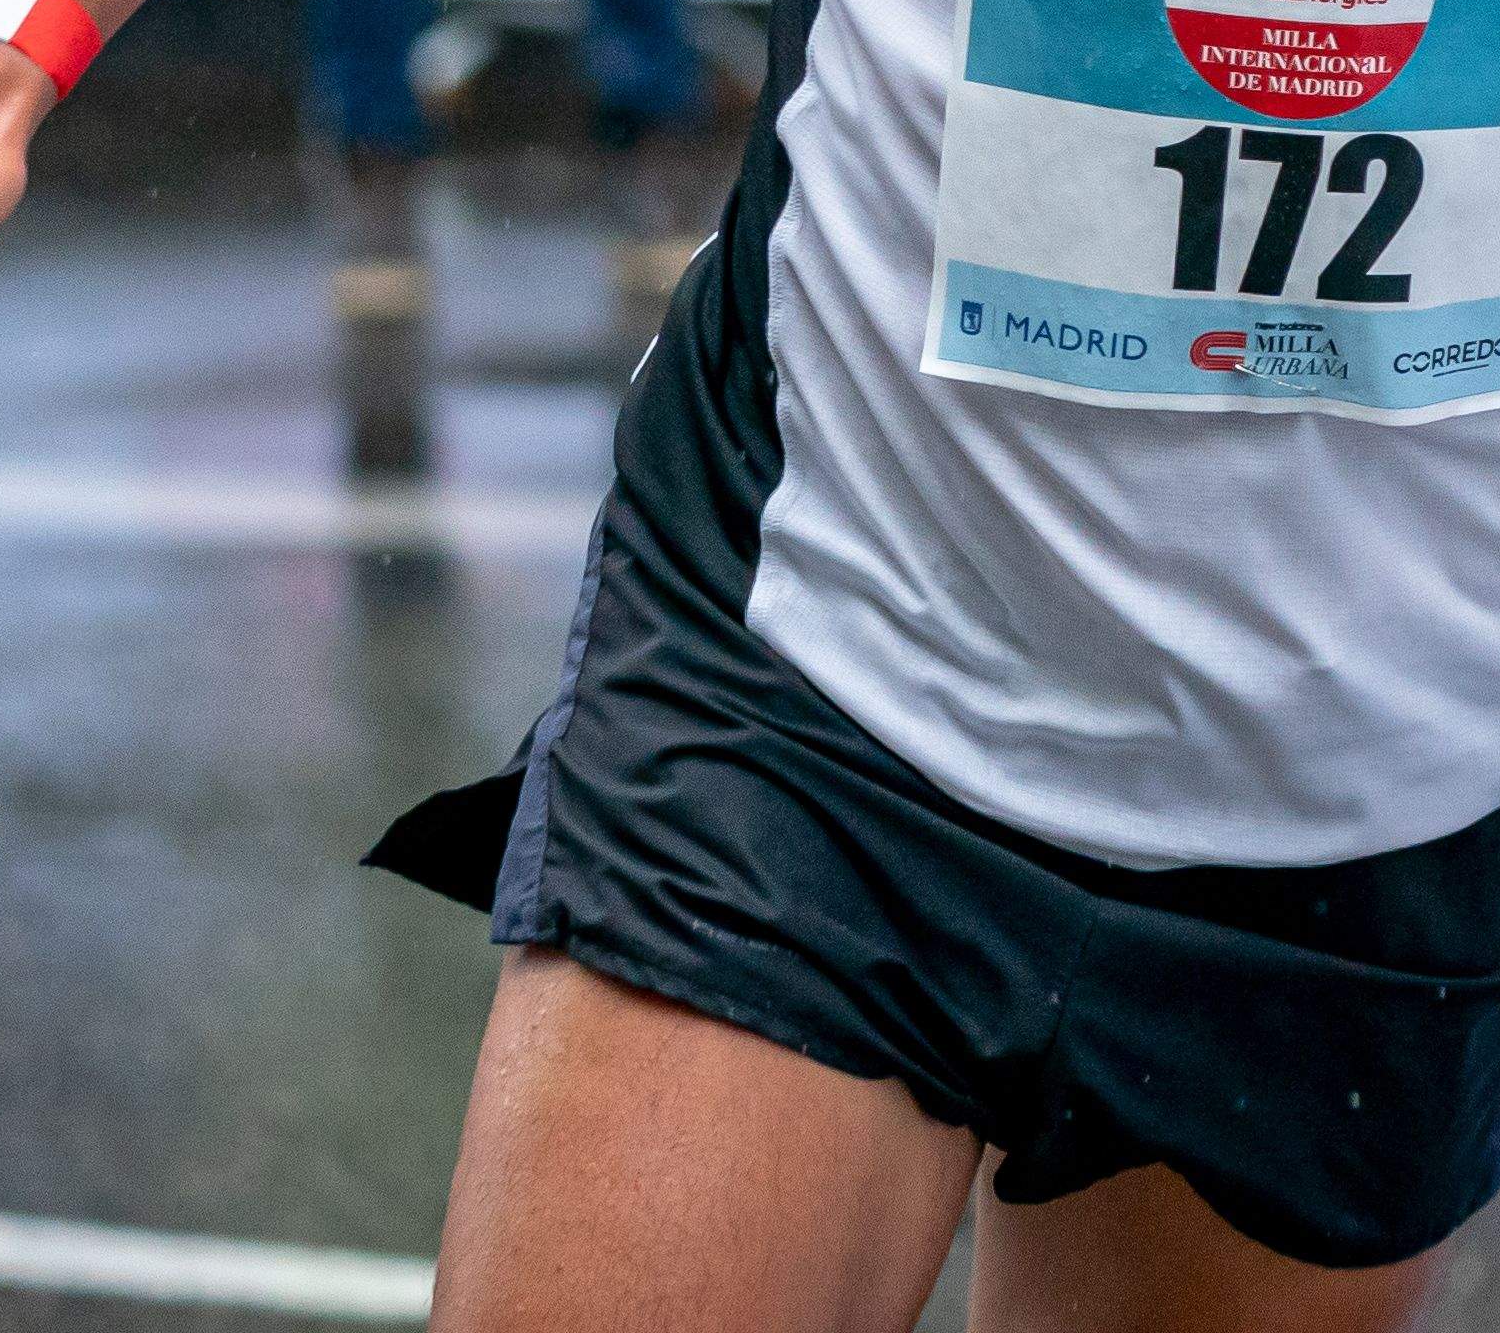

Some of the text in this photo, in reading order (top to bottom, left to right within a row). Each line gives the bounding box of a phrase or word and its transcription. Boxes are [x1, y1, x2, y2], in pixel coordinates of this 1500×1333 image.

[1262, 27, 1340, 51] MILLA
[1227, 70, 1364, 98] DE MADRID
[1153, 124, 1424, 303] 172
[1005, 311, 1148, 361] MADRID
[1254, 333, 1339, 356] MILLA
[1249, 355, 1349, 380] URBANA
